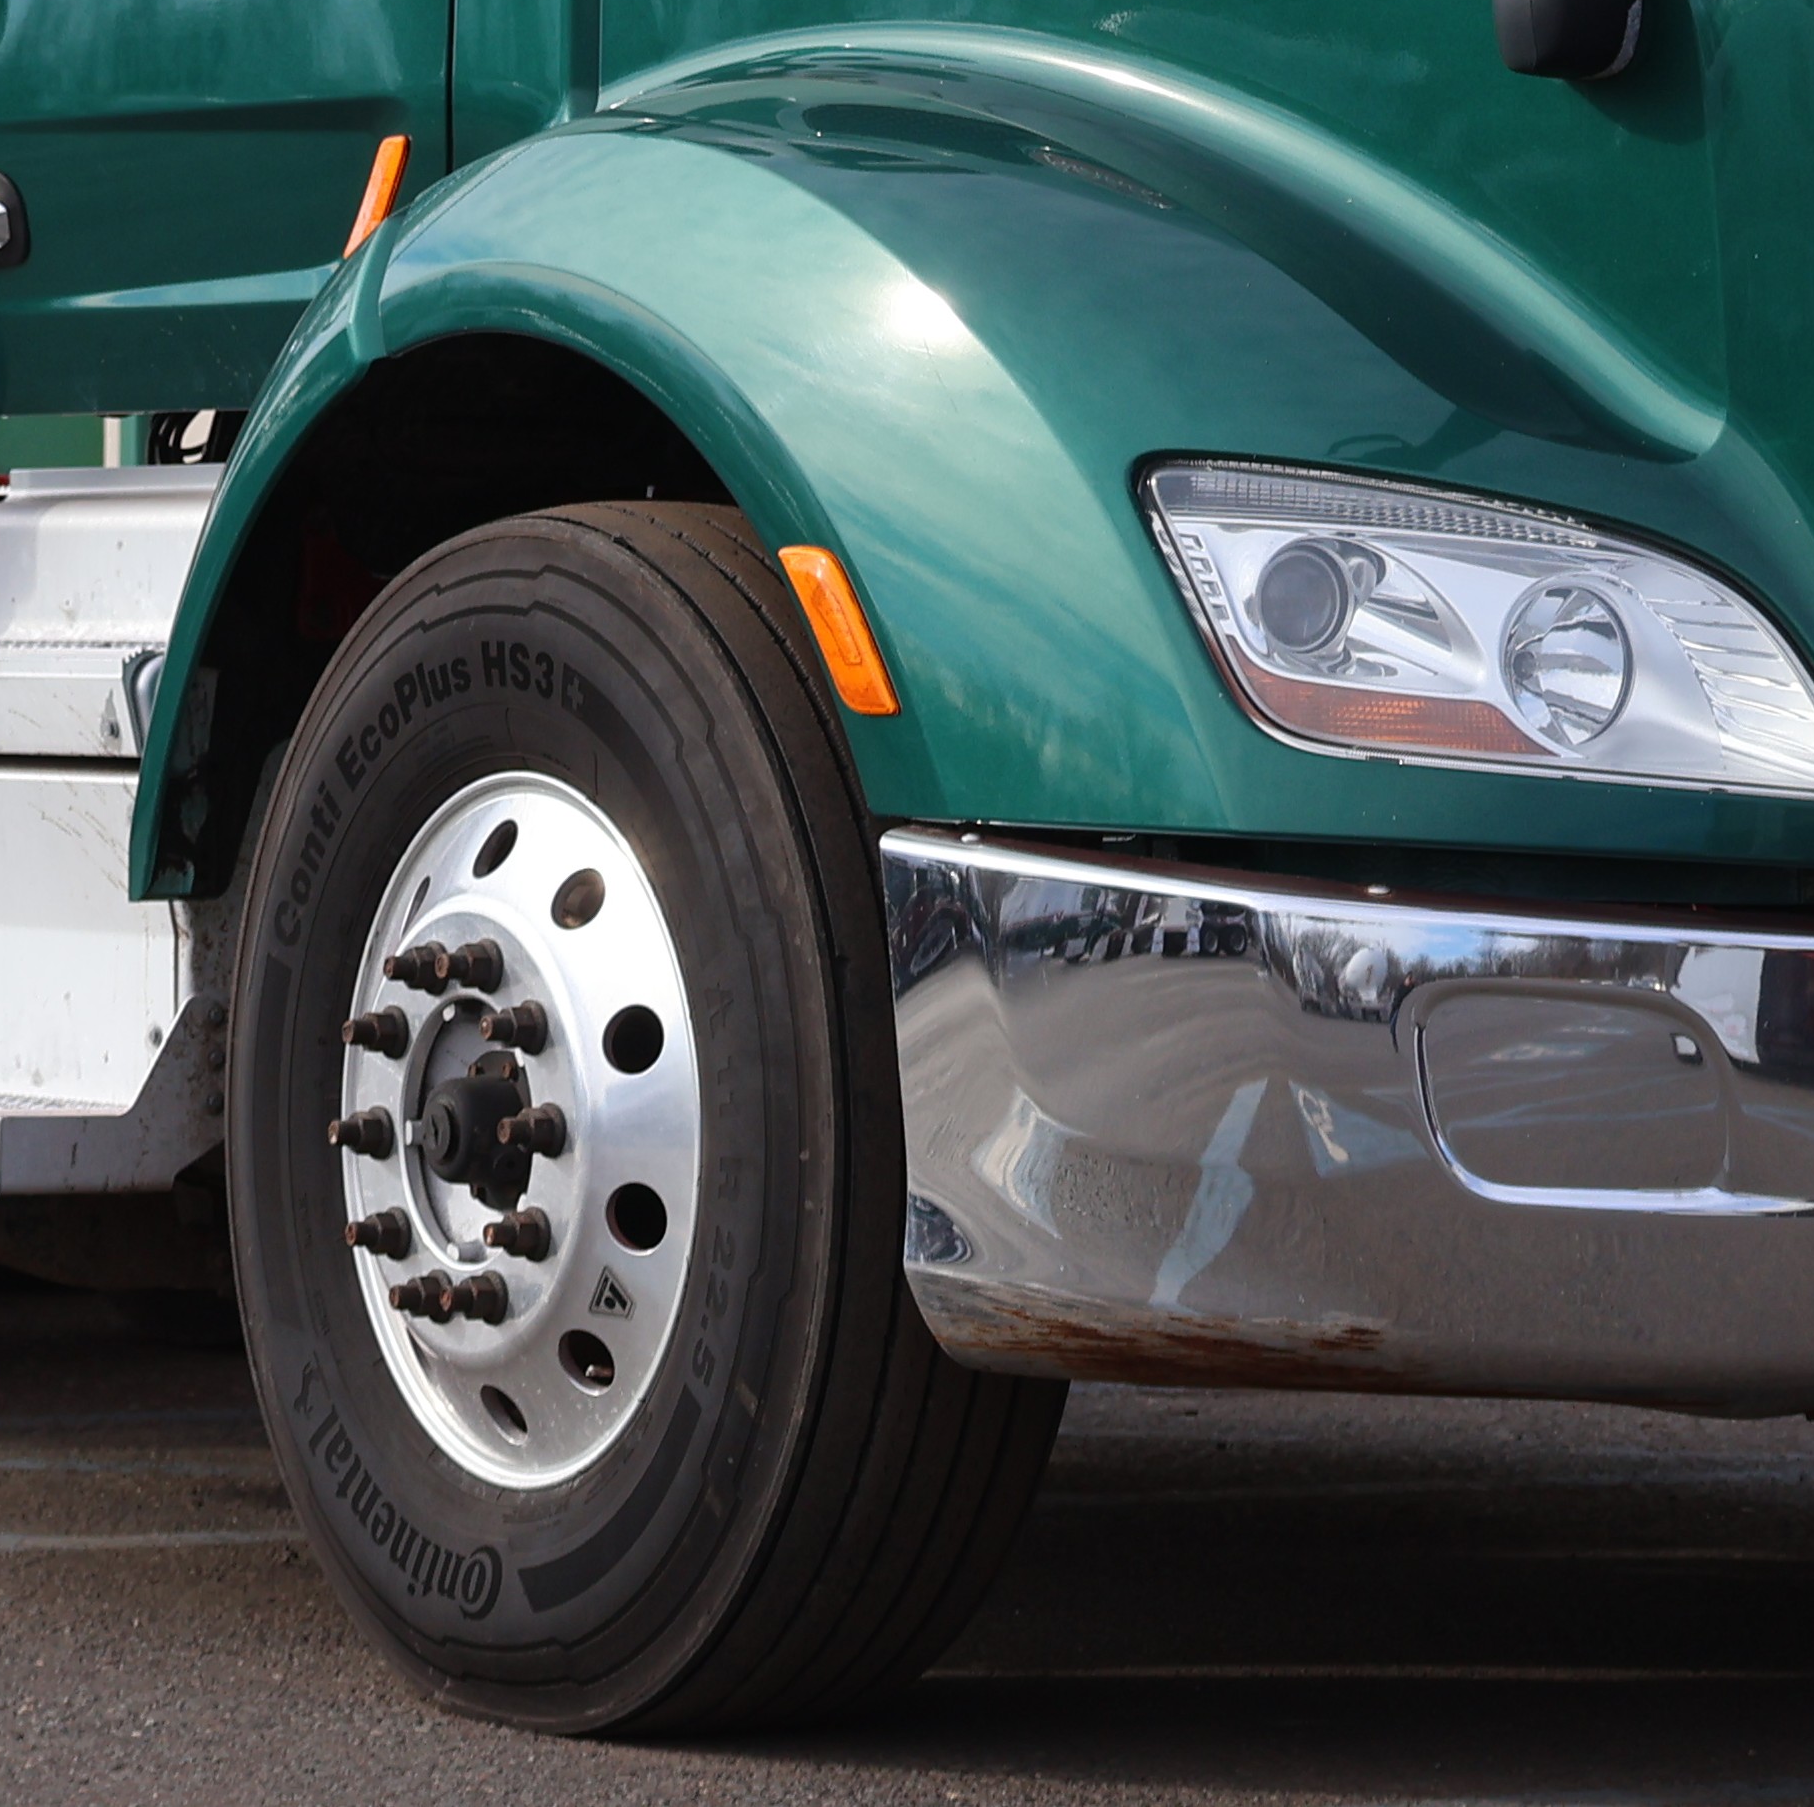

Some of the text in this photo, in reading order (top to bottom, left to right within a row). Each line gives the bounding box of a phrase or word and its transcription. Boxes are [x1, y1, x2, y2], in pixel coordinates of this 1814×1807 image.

[274, 780, 343, 947] Conti
[335, 657, 472, 793] EcoPlus
[307, 1404, 503, 1621] Continental
